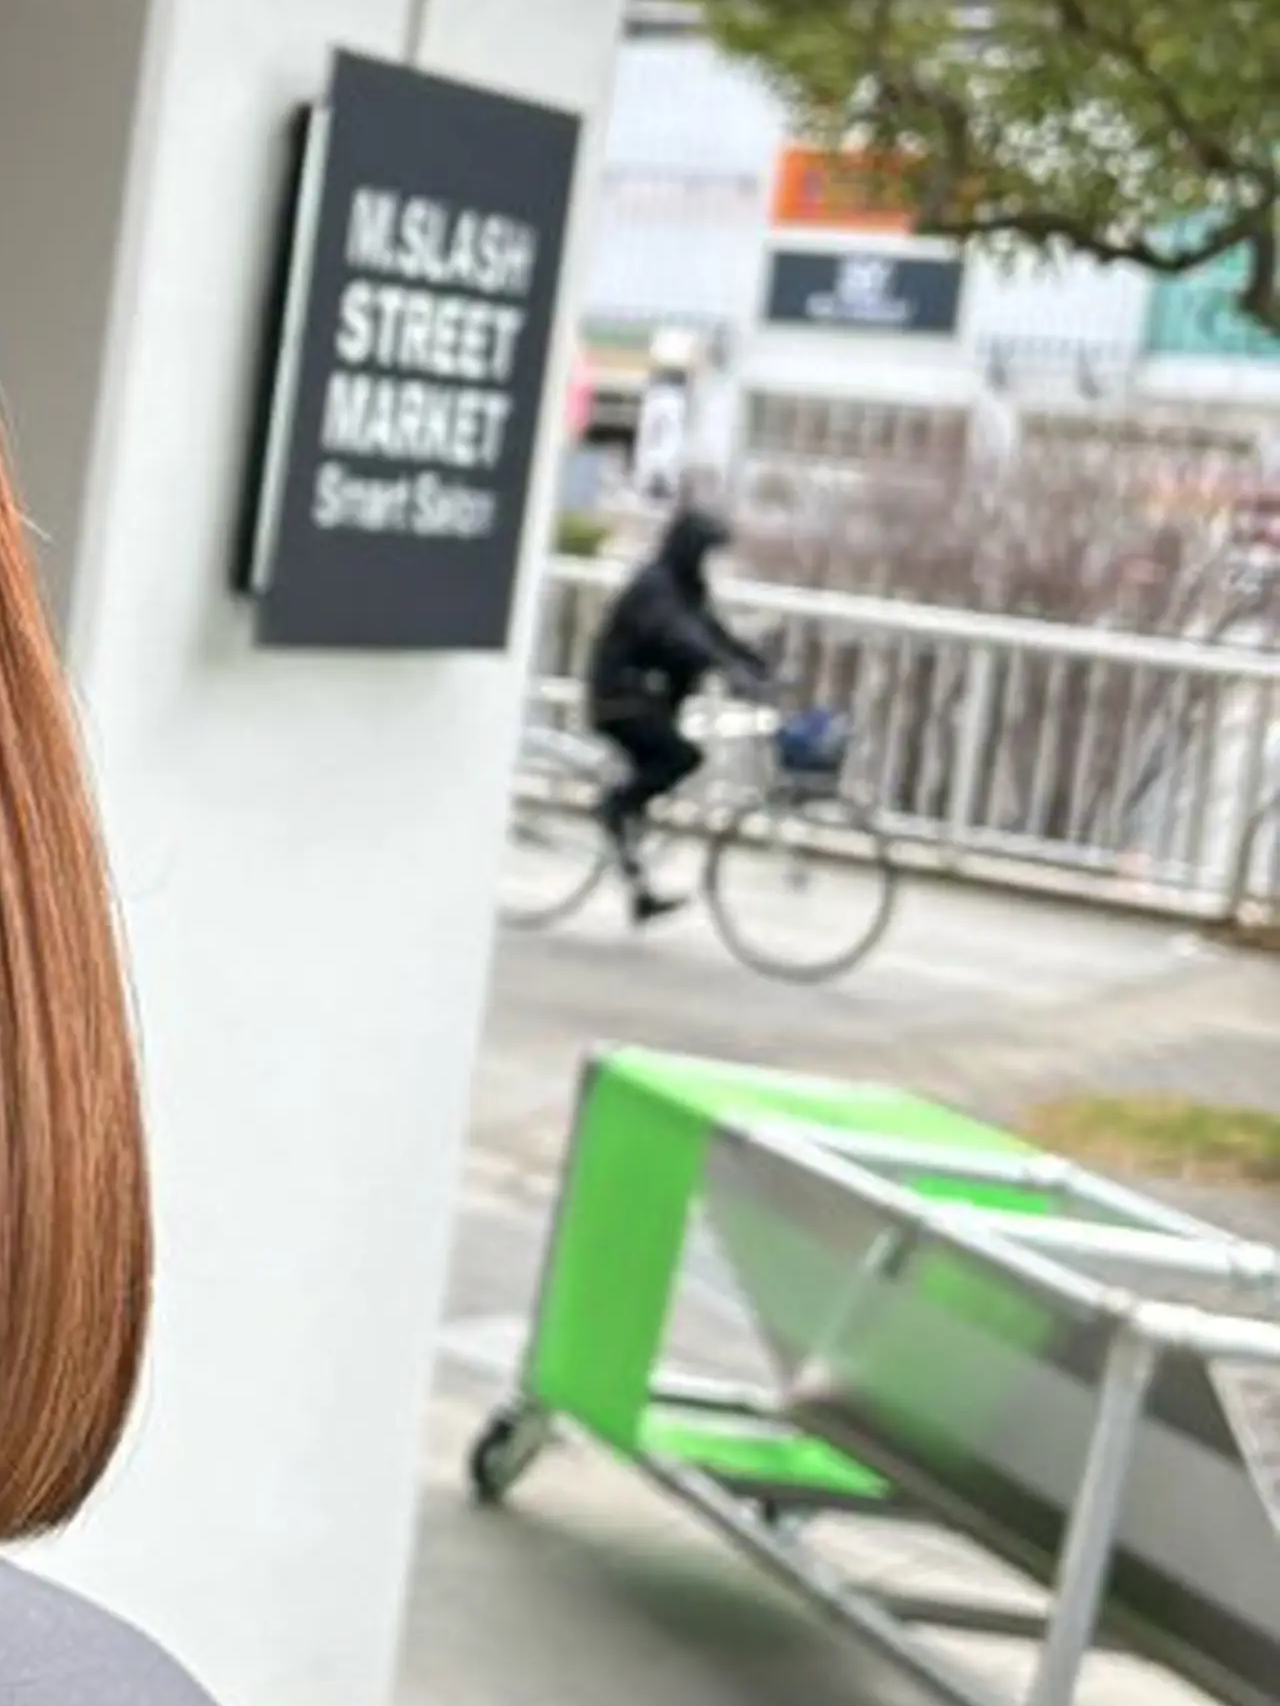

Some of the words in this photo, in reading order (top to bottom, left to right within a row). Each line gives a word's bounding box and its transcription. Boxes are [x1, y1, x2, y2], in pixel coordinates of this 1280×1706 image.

[346, 186, 538, 295] M.SLASH
[335, 277, 528, 383] STREET
[321, 370, 514, 471] MARKET
